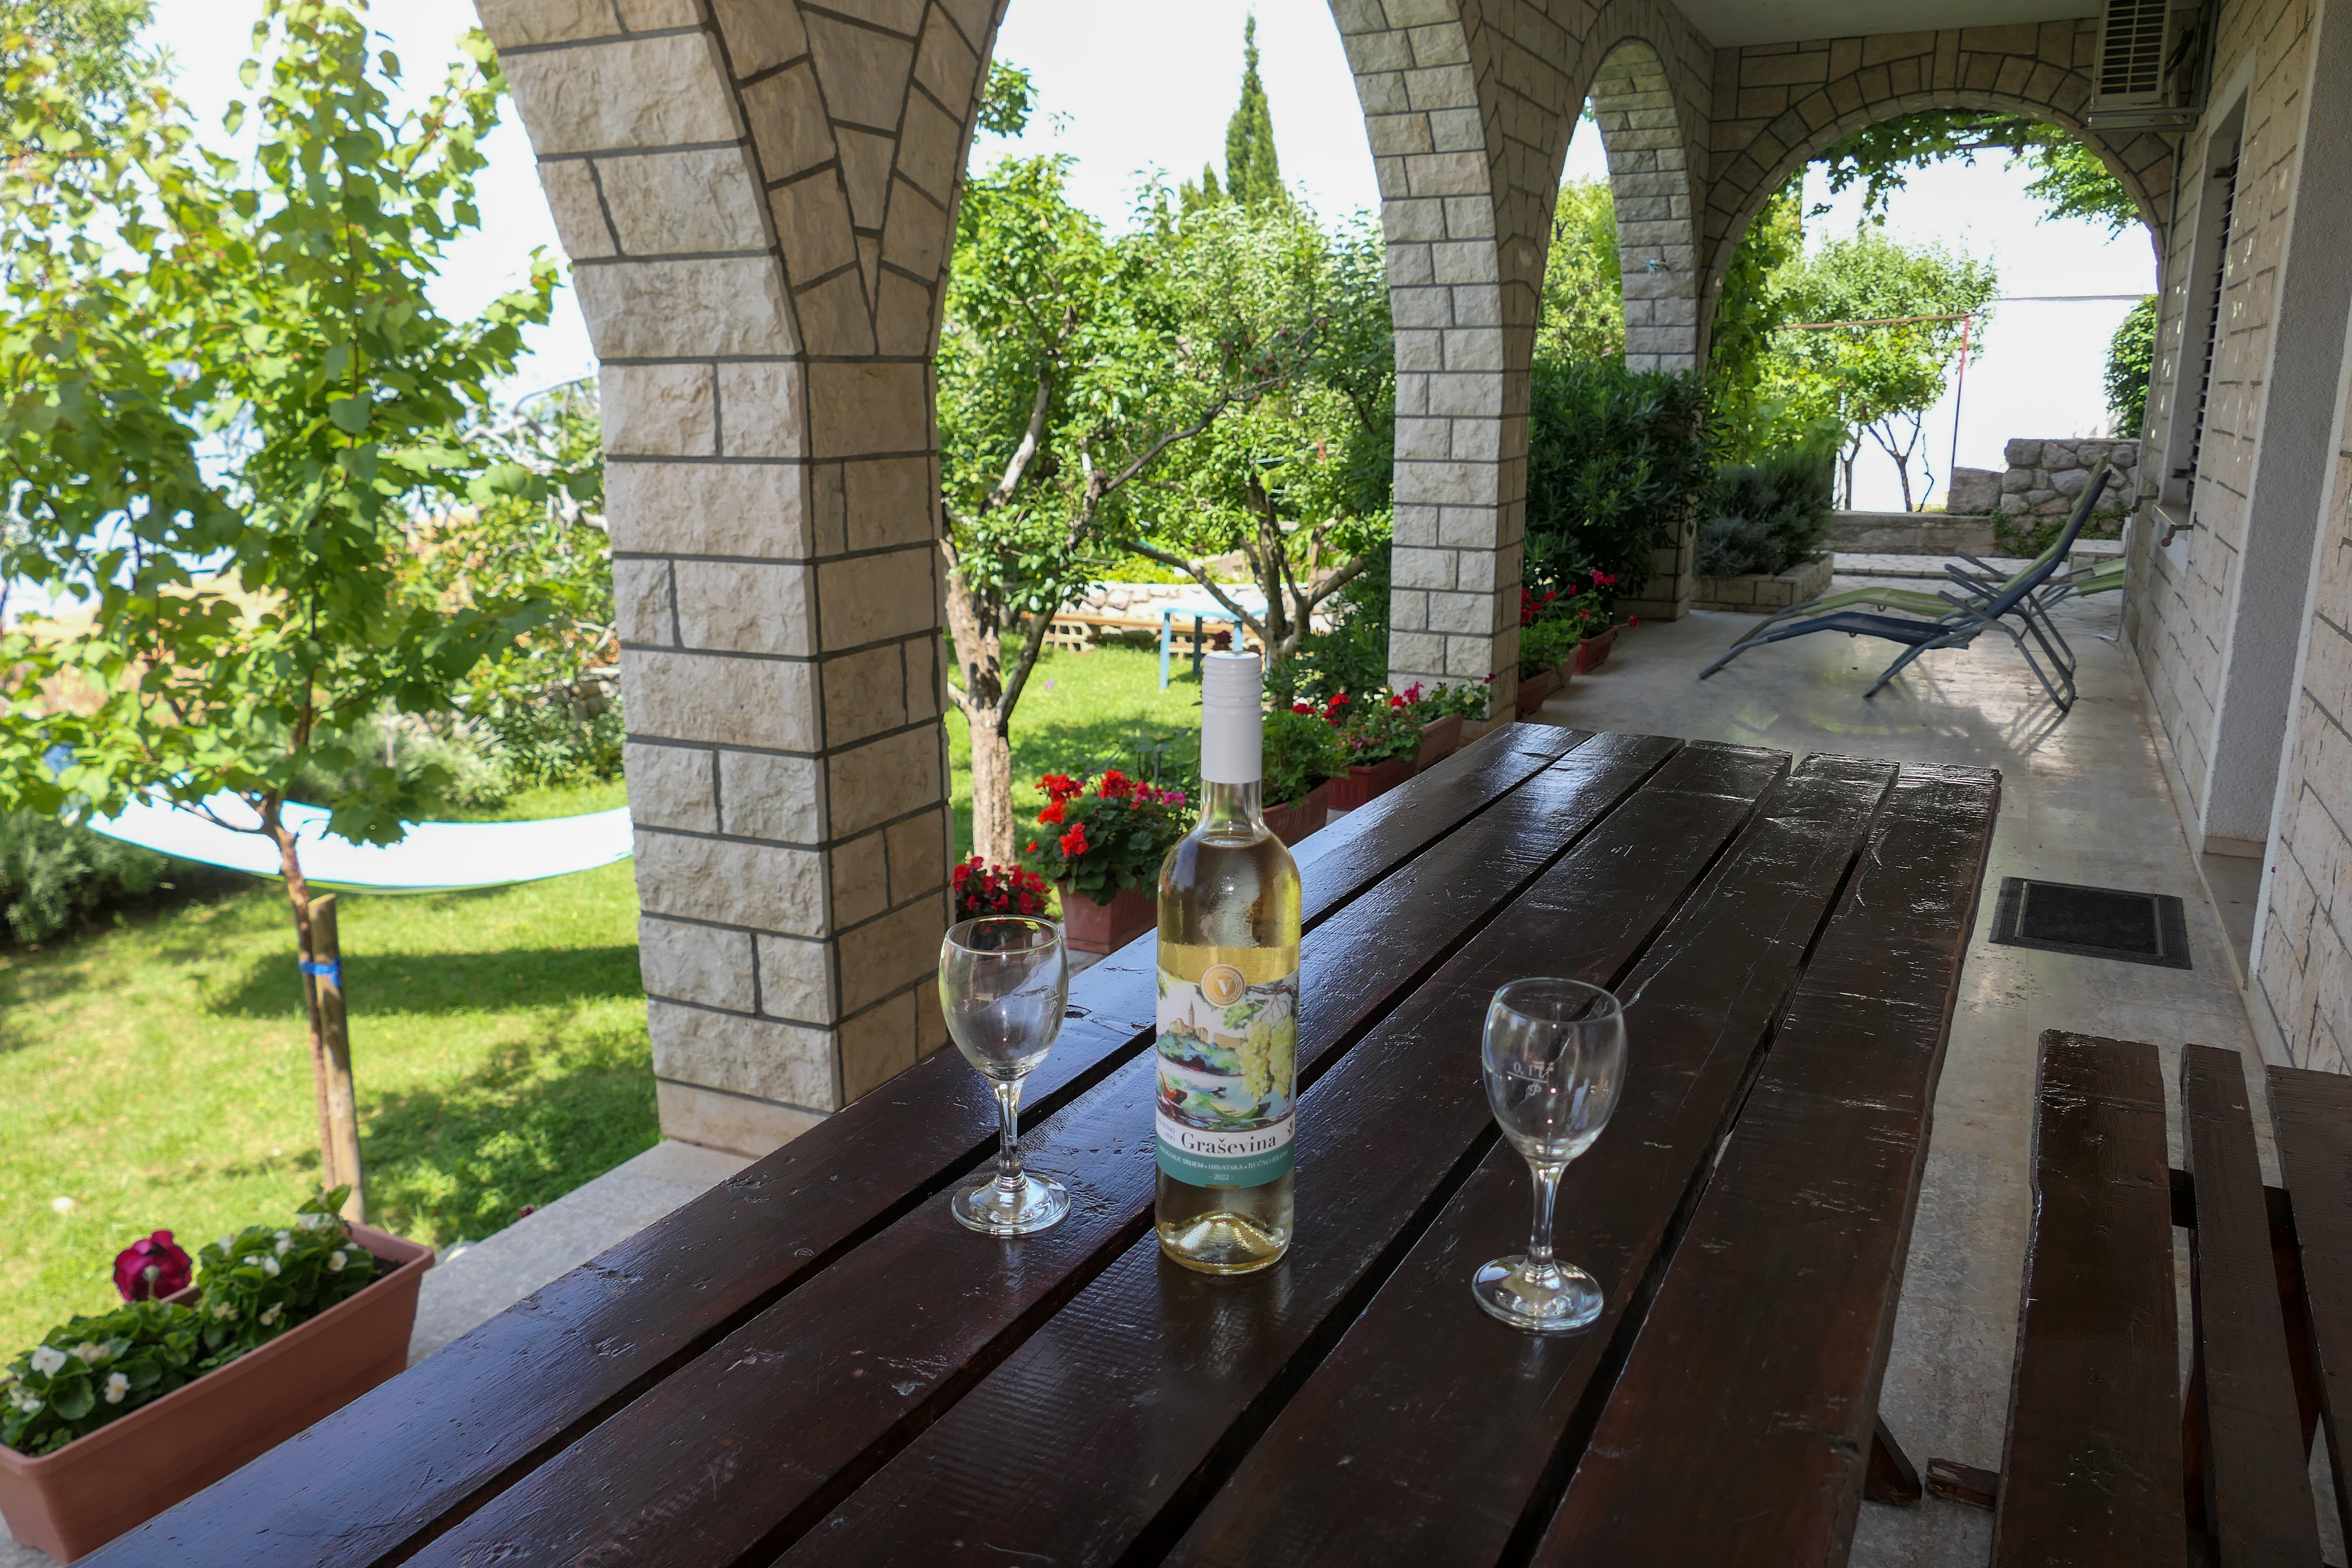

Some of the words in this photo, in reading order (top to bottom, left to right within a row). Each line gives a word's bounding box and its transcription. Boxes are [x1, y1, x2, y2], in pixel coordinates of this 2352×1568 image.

[1215, 979, 1233, 996] V
[1157, 1115, 1175, 1134] LITETNO
[1164, 1131, 1175, 1141] VINO
[1181, 1132, 1276, 1154] Graševina
[1182, 1158, 1204, 1169] SRIJEM
[1248, 1158, 1271, 1169] RUČNO
[1272, 1149, 1288, 1163] BRANO
